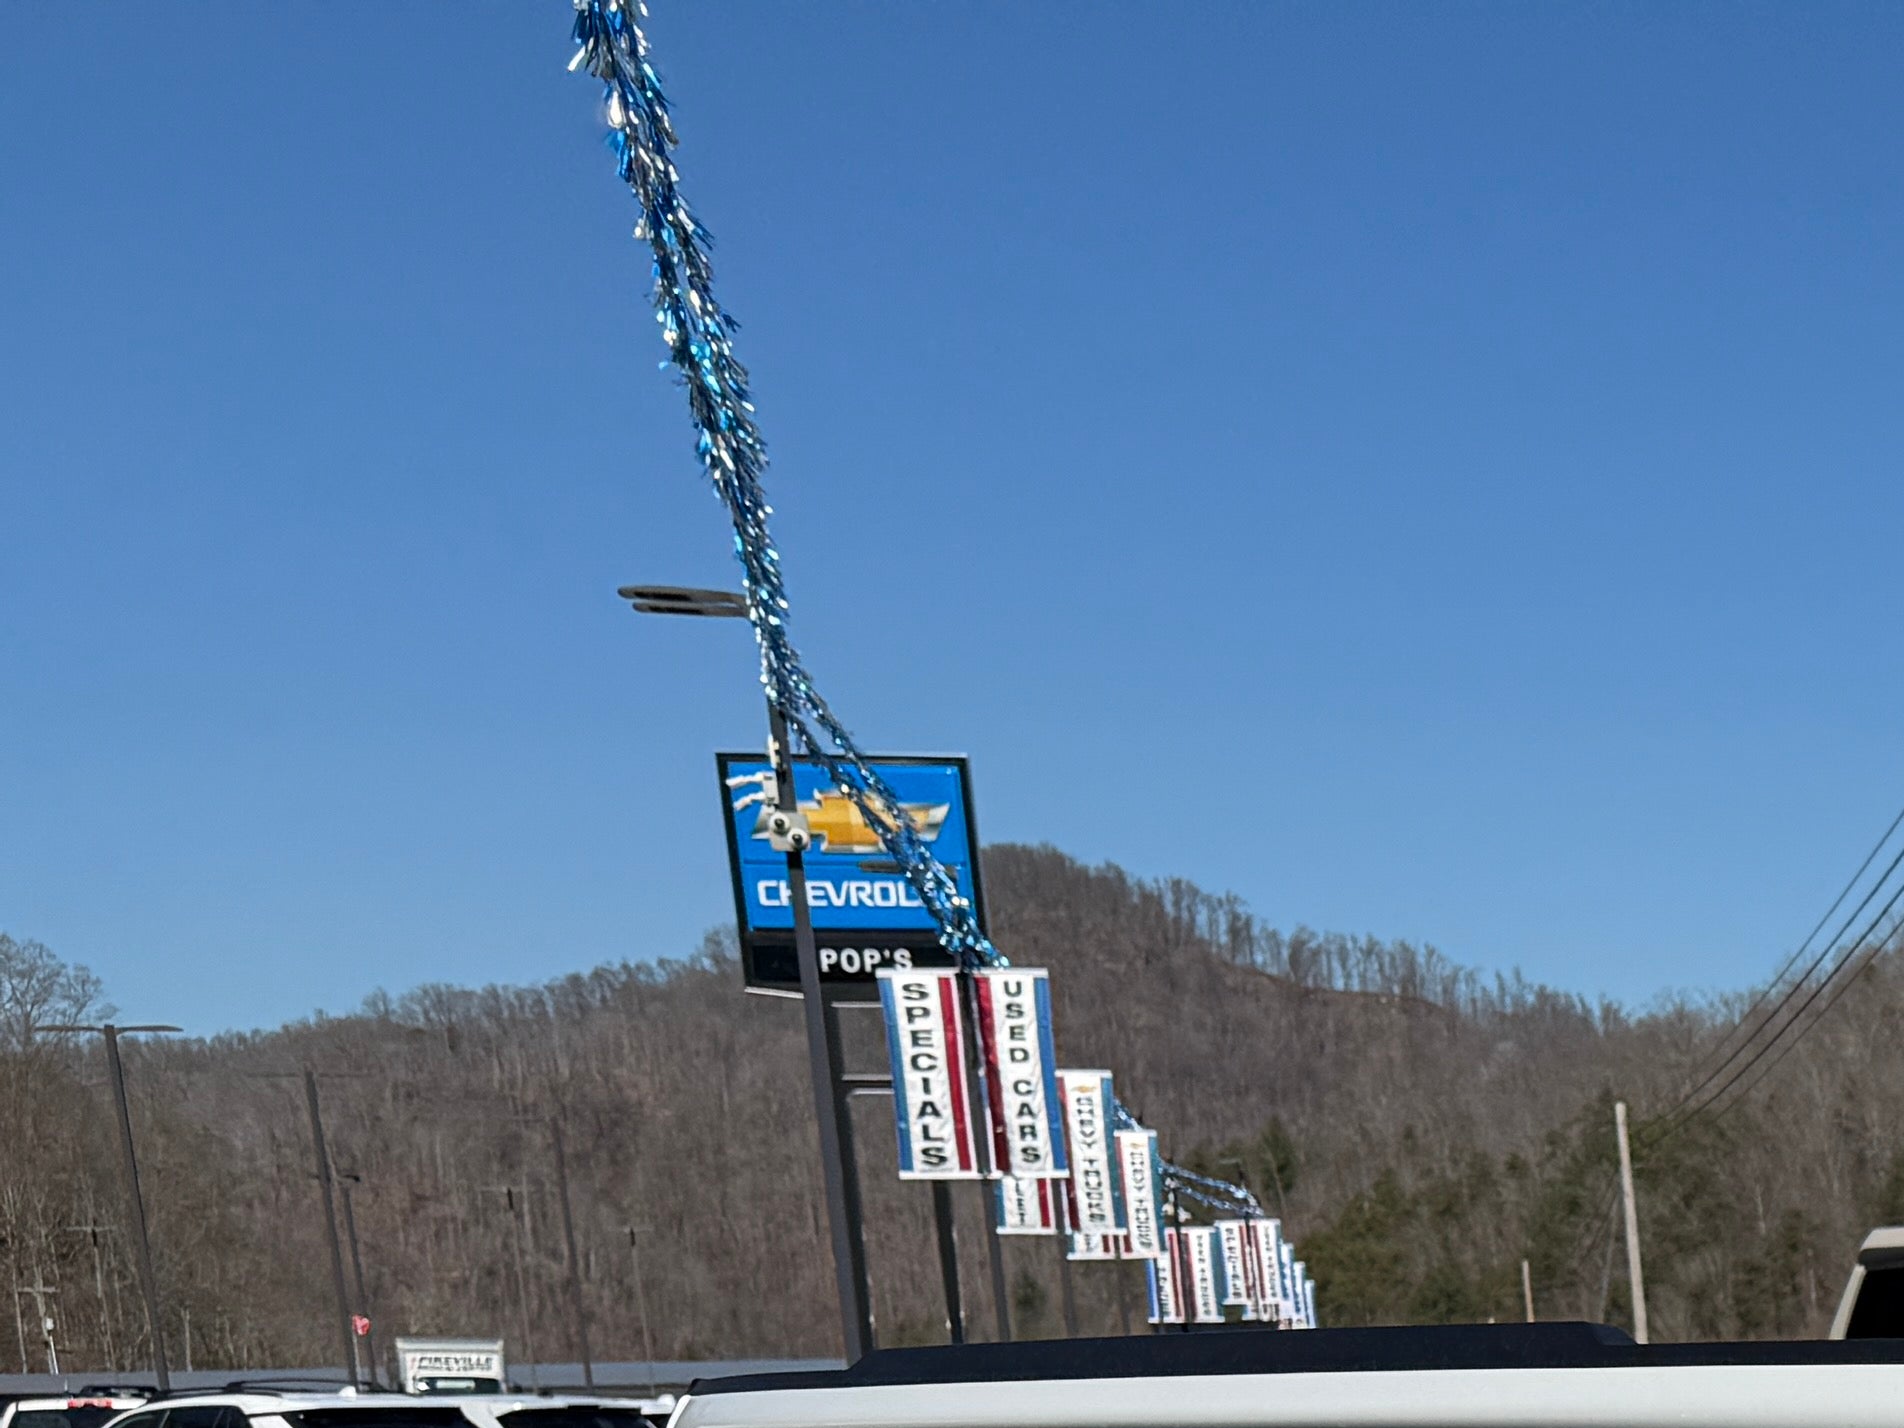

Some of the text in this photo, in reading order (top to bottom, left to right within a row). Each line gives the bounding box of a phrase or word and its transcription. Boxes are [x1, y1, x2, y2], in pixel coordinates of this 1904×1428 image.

[757, 879, 930, 908] CHEVROL
[819, 947, 914, 974] POP'S
[1003, 980, 1030, 1064] USED
[901, 982, 949, 1167] SPECIALS
[1012, 1078, 1041, 1164] CARS
